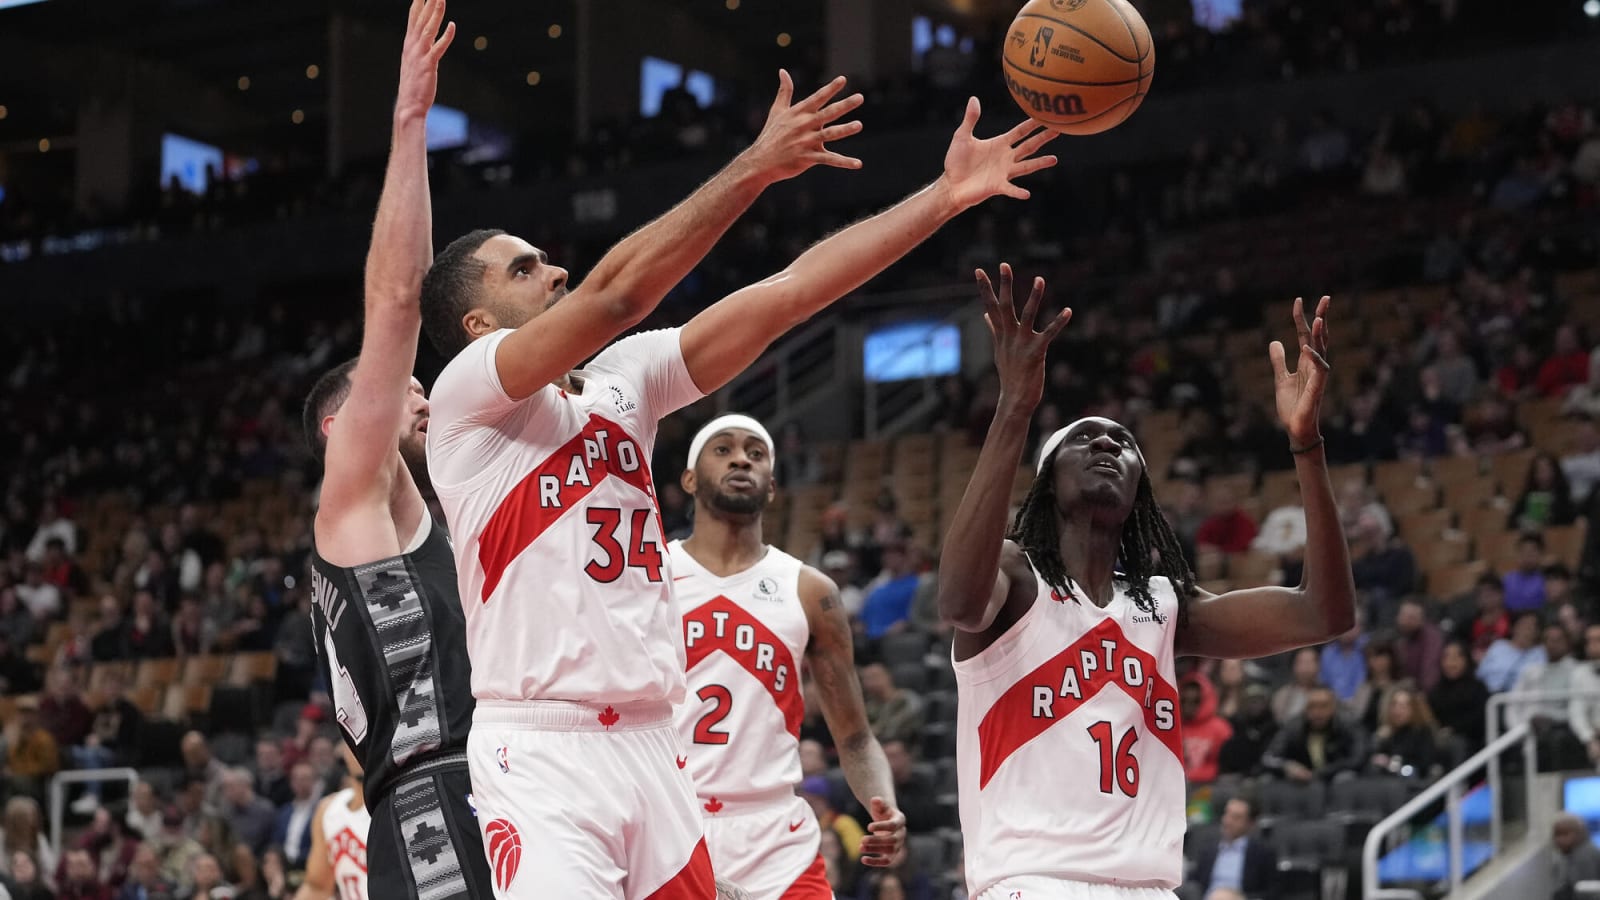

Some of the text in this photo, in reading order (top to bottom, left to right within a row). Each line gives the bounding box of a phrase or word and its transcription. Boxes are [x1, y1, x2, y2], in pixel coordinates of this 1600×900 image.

[539, 429, 659, 514] RAPTO
[584, 507, 663, 583] 34
[686, 611, 788, 692] PTORS
[1132, 615, 1150, 624] Sun
[693, 684, 733, 745] 2
[1086, 720, 1140, 798] 16
